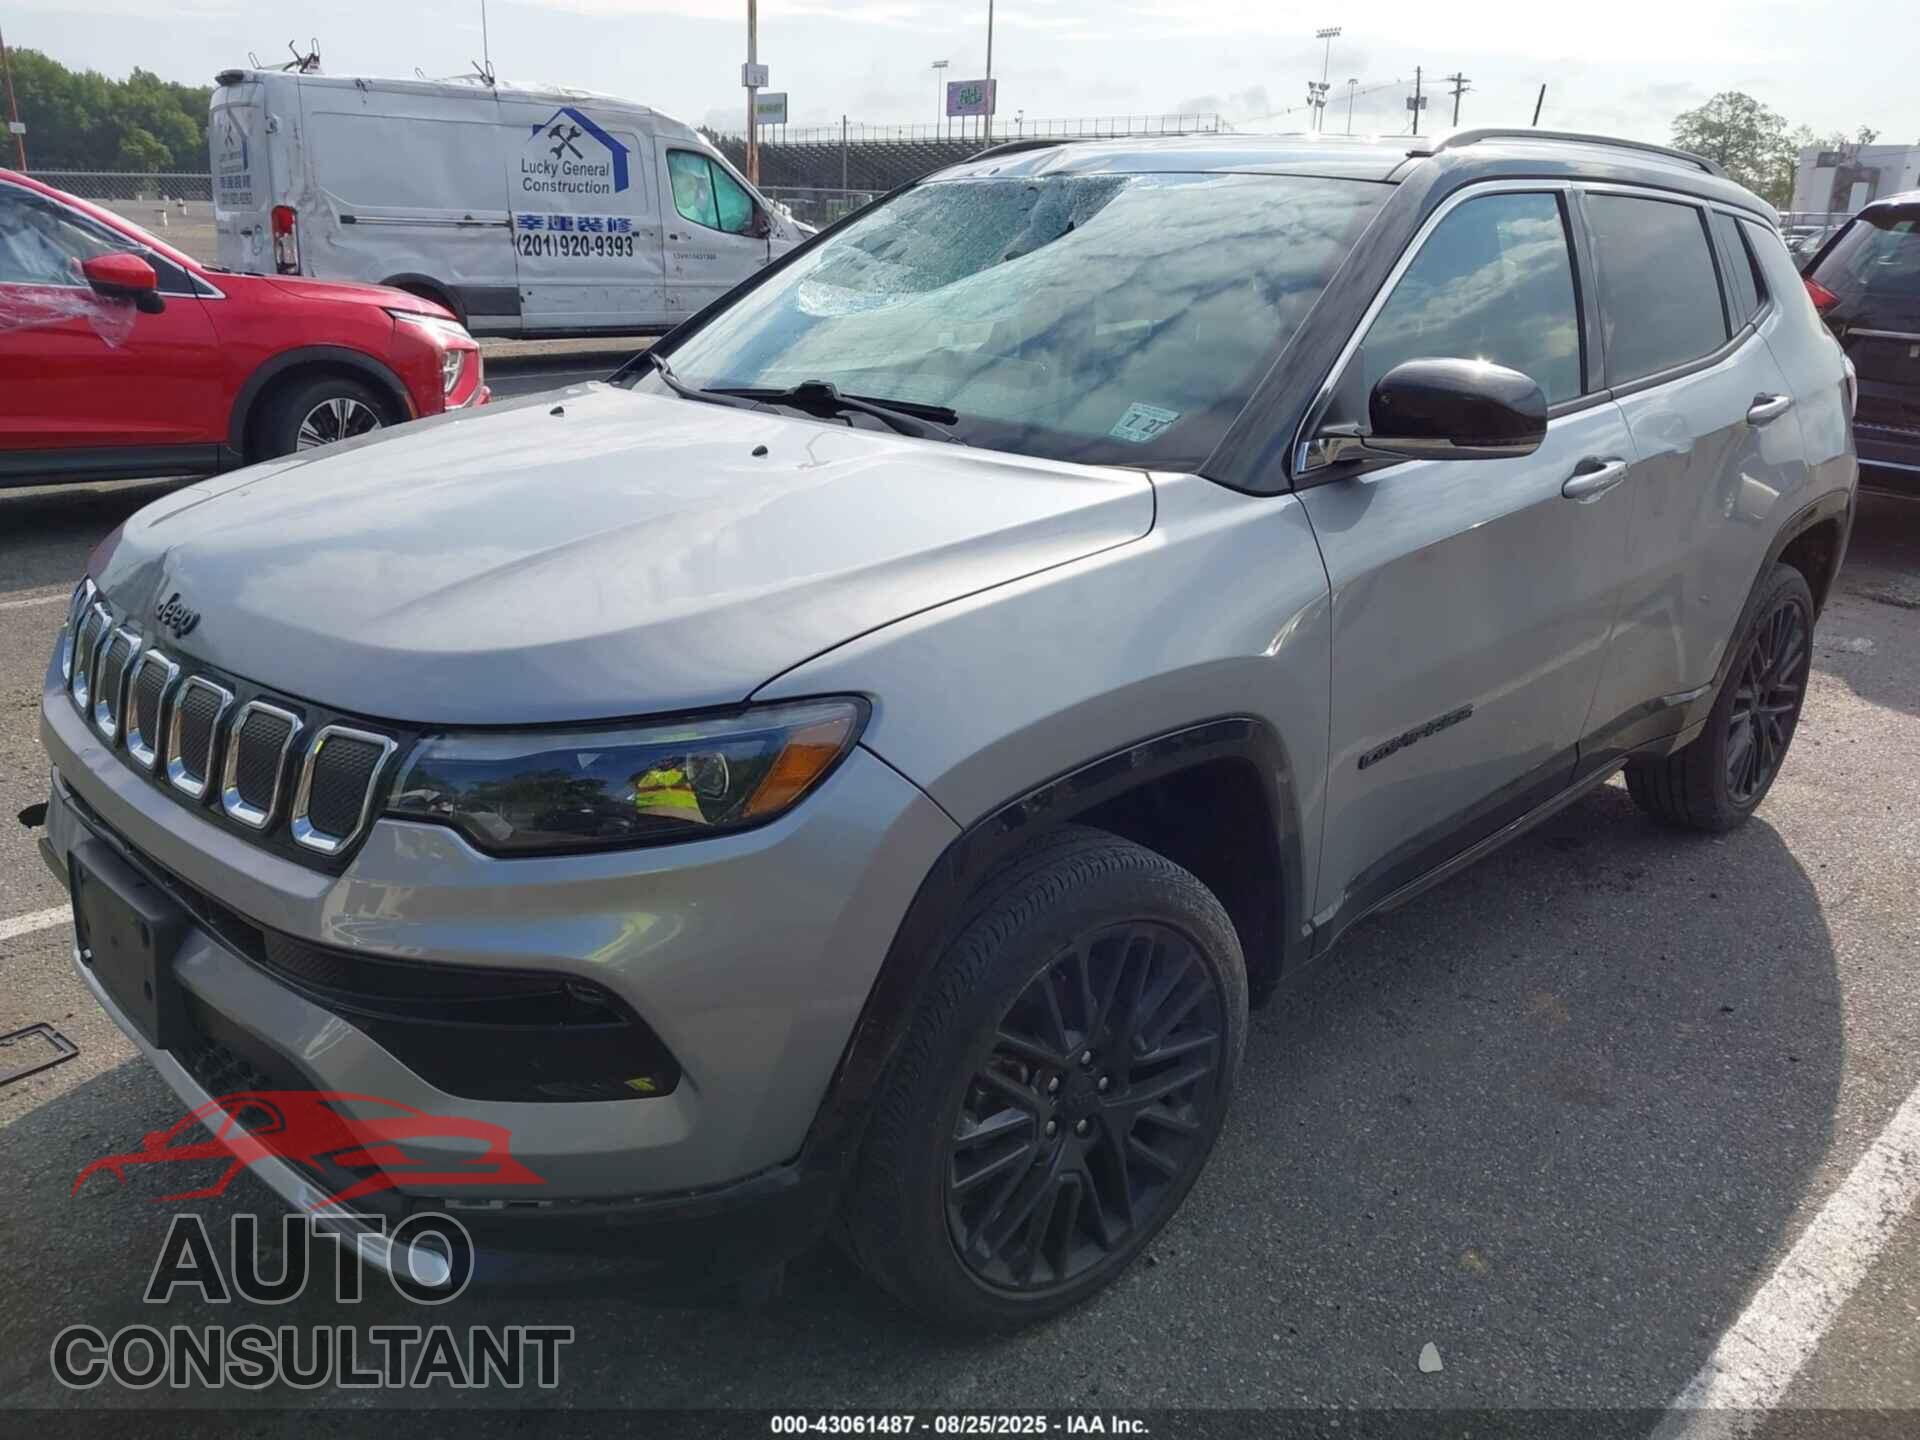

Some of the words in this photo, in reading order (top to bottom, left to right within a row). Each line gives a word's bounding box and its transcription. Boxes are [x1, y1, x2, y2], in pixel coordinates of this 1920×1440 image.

[521, 158, 559, 178] Lucky
[562, 160, 609, 177] General
[522, 177, 610, 194] Construction
[516, 234, 634, 257] (201)920-9393
